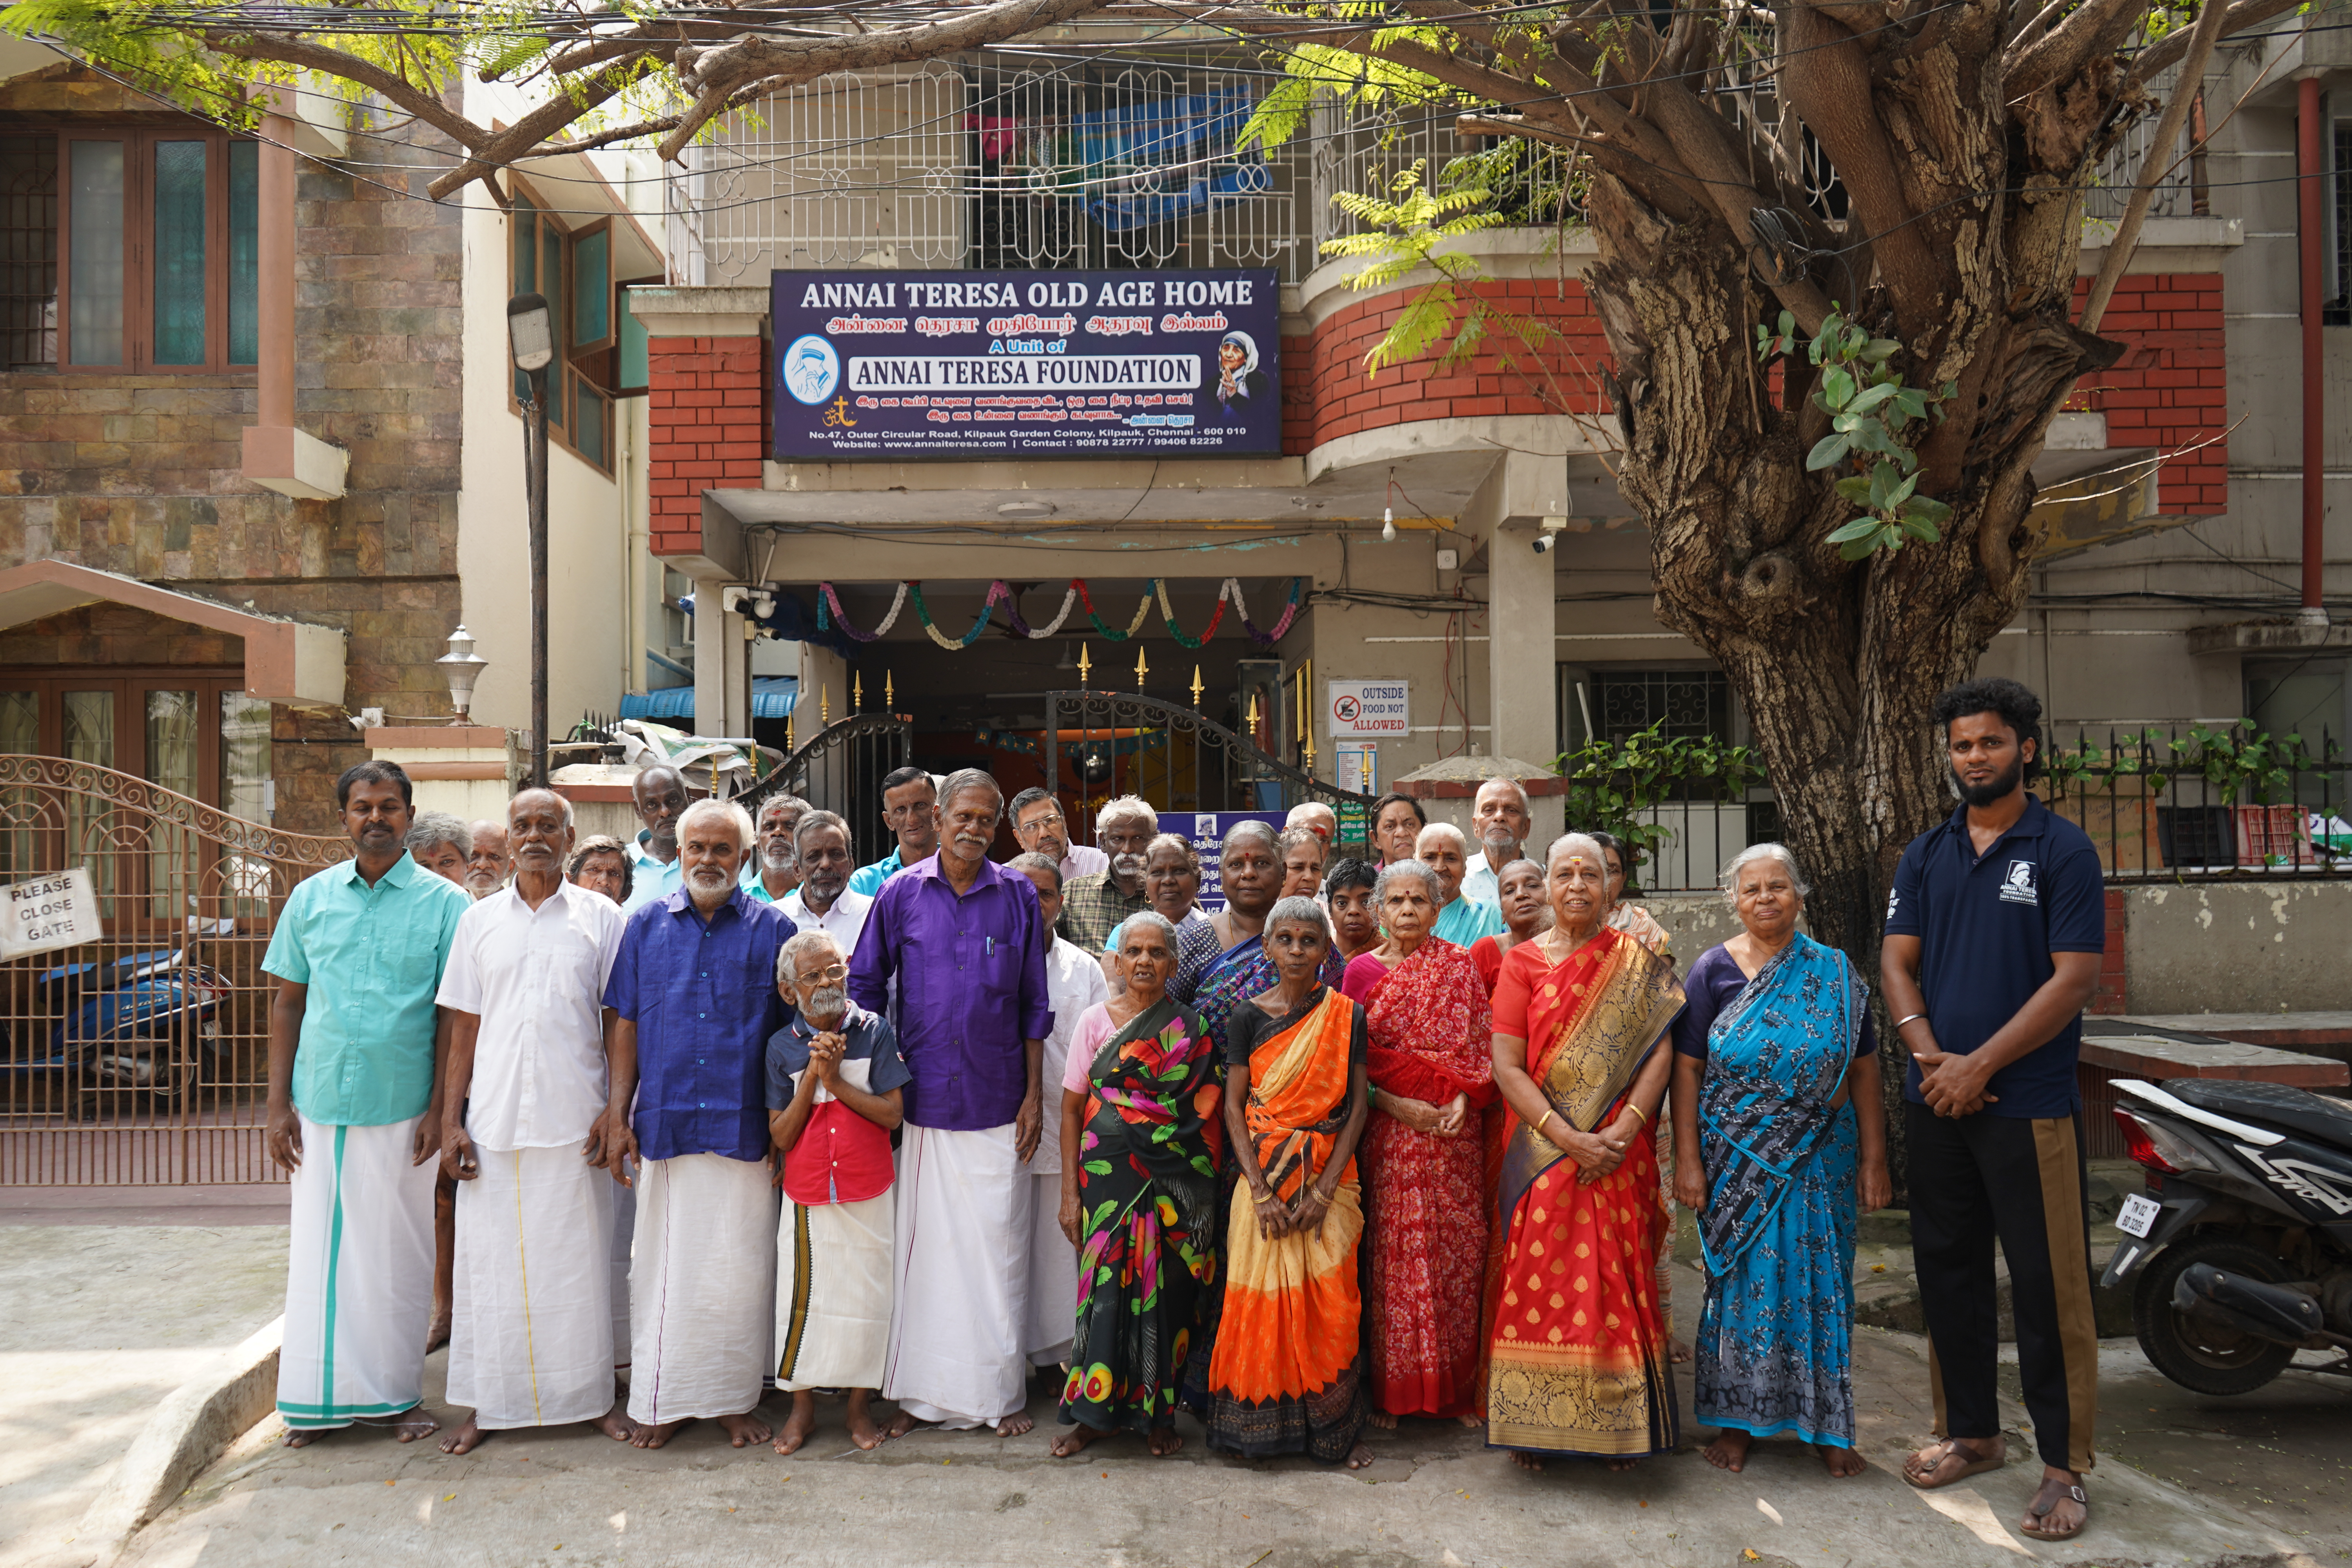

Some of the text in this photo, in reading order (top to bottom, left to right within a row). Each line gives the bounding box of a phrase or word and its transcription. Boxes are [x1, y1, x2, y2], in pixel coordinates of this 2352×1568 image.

[800, 281, 1252, 308] ANNAI TERESA OLD AGE HOME
[826, 311, 1228, 336] அன்னை தெரசா முதியோர் ஆதரவு இல்லம்
[989, 339, 1066, 354] A Unit of
[857, 359, 1191, 384] ANNAI TERESA FOUNDATION
[880, 397, 900, 406] கை
[1088, 396, 1107, 405] கை
[953, 411, 971, 420] கை
[974, 409, 1015, 421] உன்னை
[1018, 409, 1067, 421] வணங்கும்
[809, 431, 844, 439] No.47,
[964, 430, 1006, 439] Kilpauk
[1054, 430, 1095, 438] Colony,
[1099, 429, 1143, 437] Kilpauk,
[884, 439, 1006, 448] www.annaiteresa.com
[1363, 688, 1404, 699] OUTSIDE
[1363, 704, 1404, 713] FOOD NOT
[1353, 720, 1405, 730] ALLOWED
[11, 878, 72, 902] PLEASE
[2003, 889, 2036, 898] FOUNDATION
[20, 899, 73, 920] CLOSE
[28, 920, 74, 940] GATE
[2131, 1201, 2148, 1216] TN 02
[2122, 1215, 2144, 1232] BD 3205
